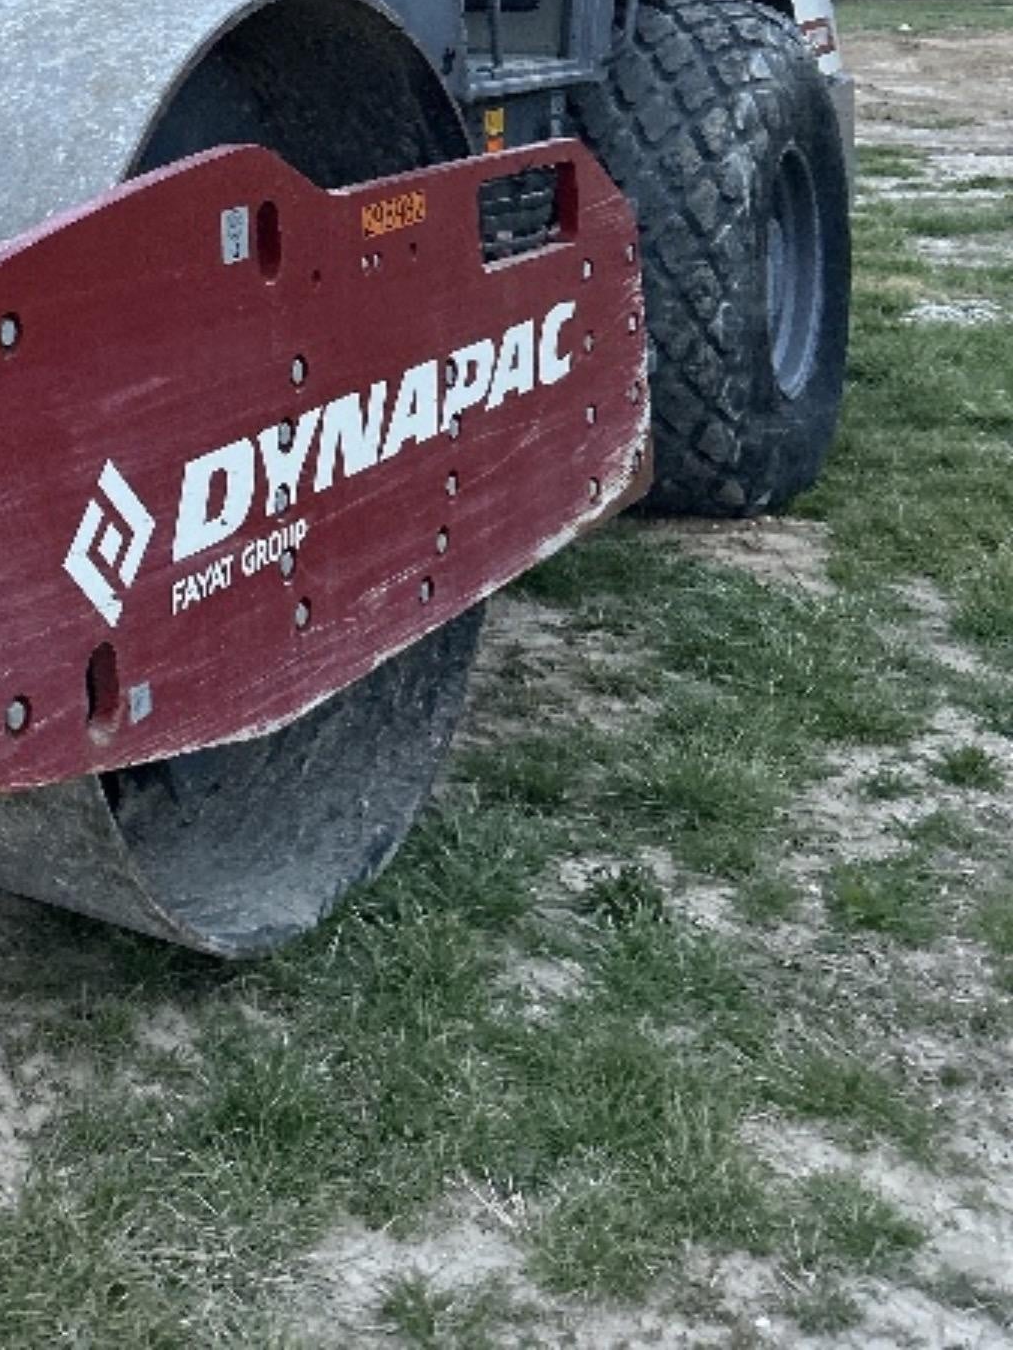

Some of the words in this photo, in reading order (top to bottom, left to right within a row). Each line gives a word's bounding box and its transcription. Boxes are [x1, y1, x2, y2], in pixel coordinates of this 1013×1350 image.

[172, 300, 577, 563] DYNAPAC
[172, 554, 234, 616] FAYAT
[241, 518, 309, 577] GROUP
